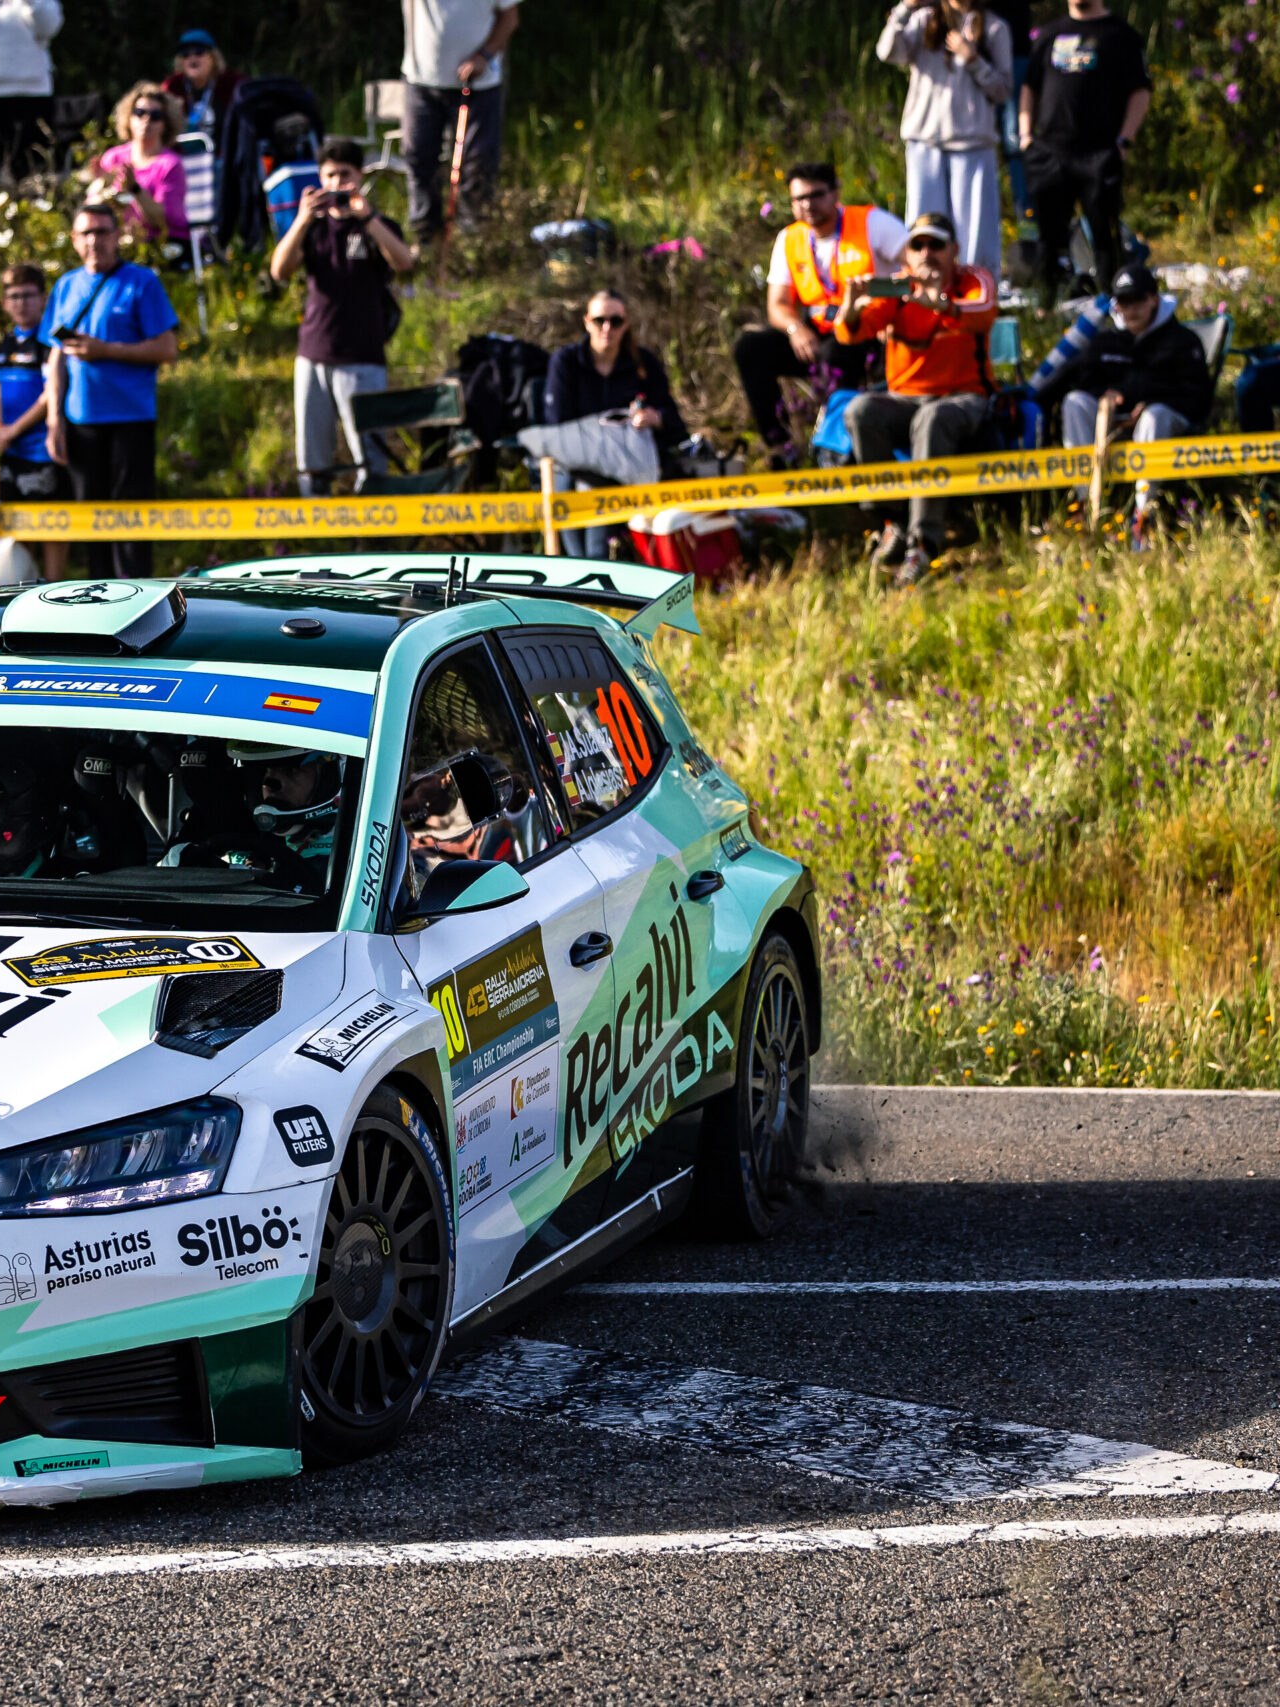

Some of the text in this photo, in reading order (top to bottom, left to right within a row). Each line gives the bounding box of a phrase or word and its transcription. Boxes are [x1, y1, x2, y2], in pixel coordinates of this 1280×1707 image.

[977, 449, 1146, 485] ZONA PUBICO
[1172, 444, 1235, 469] ZONA
[784, 465, 951, 497] ZONA PUBLICO
[420, 499, 570, 525] ZONA PUBLIO
[594, 482, 759, 516] ZONA PUBLICO
[91, 507, 232, 531] ZONA PUBLICO
[254, 504, 398, 529] ZONA PUBLICO
[240, 565, 620, 593] ODA
[666, 582, 692, 612] SKODA
[12, 679, 157, 694] MICHELIN
[595, 681, 653, 787] 10
[84, 758, 112, 772] OMP
[180, 753, 207, 765] OMP
[360, 820, 388, 912] SKODA
[32, 960, 103, 974] SIERRA
[104, 952, 190, 965] MORENA
[193, 944, 235, 957] 10
[484, 967, 508, 994] RALLY
[466, 983, 489, 1017] 43
[337, 1002, 396, 1042] MICHELIN
[431, 984, 465, 1060] 10
[563, 881, 696, 1170] Recalvi
[472, 1026, 535, 1077] FIA ERC Championship
[613, 1010, 734, 1181] SKODA
[282, 1115, 323, 1141] UFI
[522, 1125, 534, 1142] Junta
[292, 1137, 328, 1155] FILTERS
[422, 1131, 455, 1251] MICHELIN
[177, 1205, 290, 1267] Silbö
[44, 1229, 152, 1275] Asturias
[47, 1251, 157, 1294] paraíso natural
[215, 1257, 279, 1281] Telecom
[42, 1457, 101, 1471] MICHELIN
